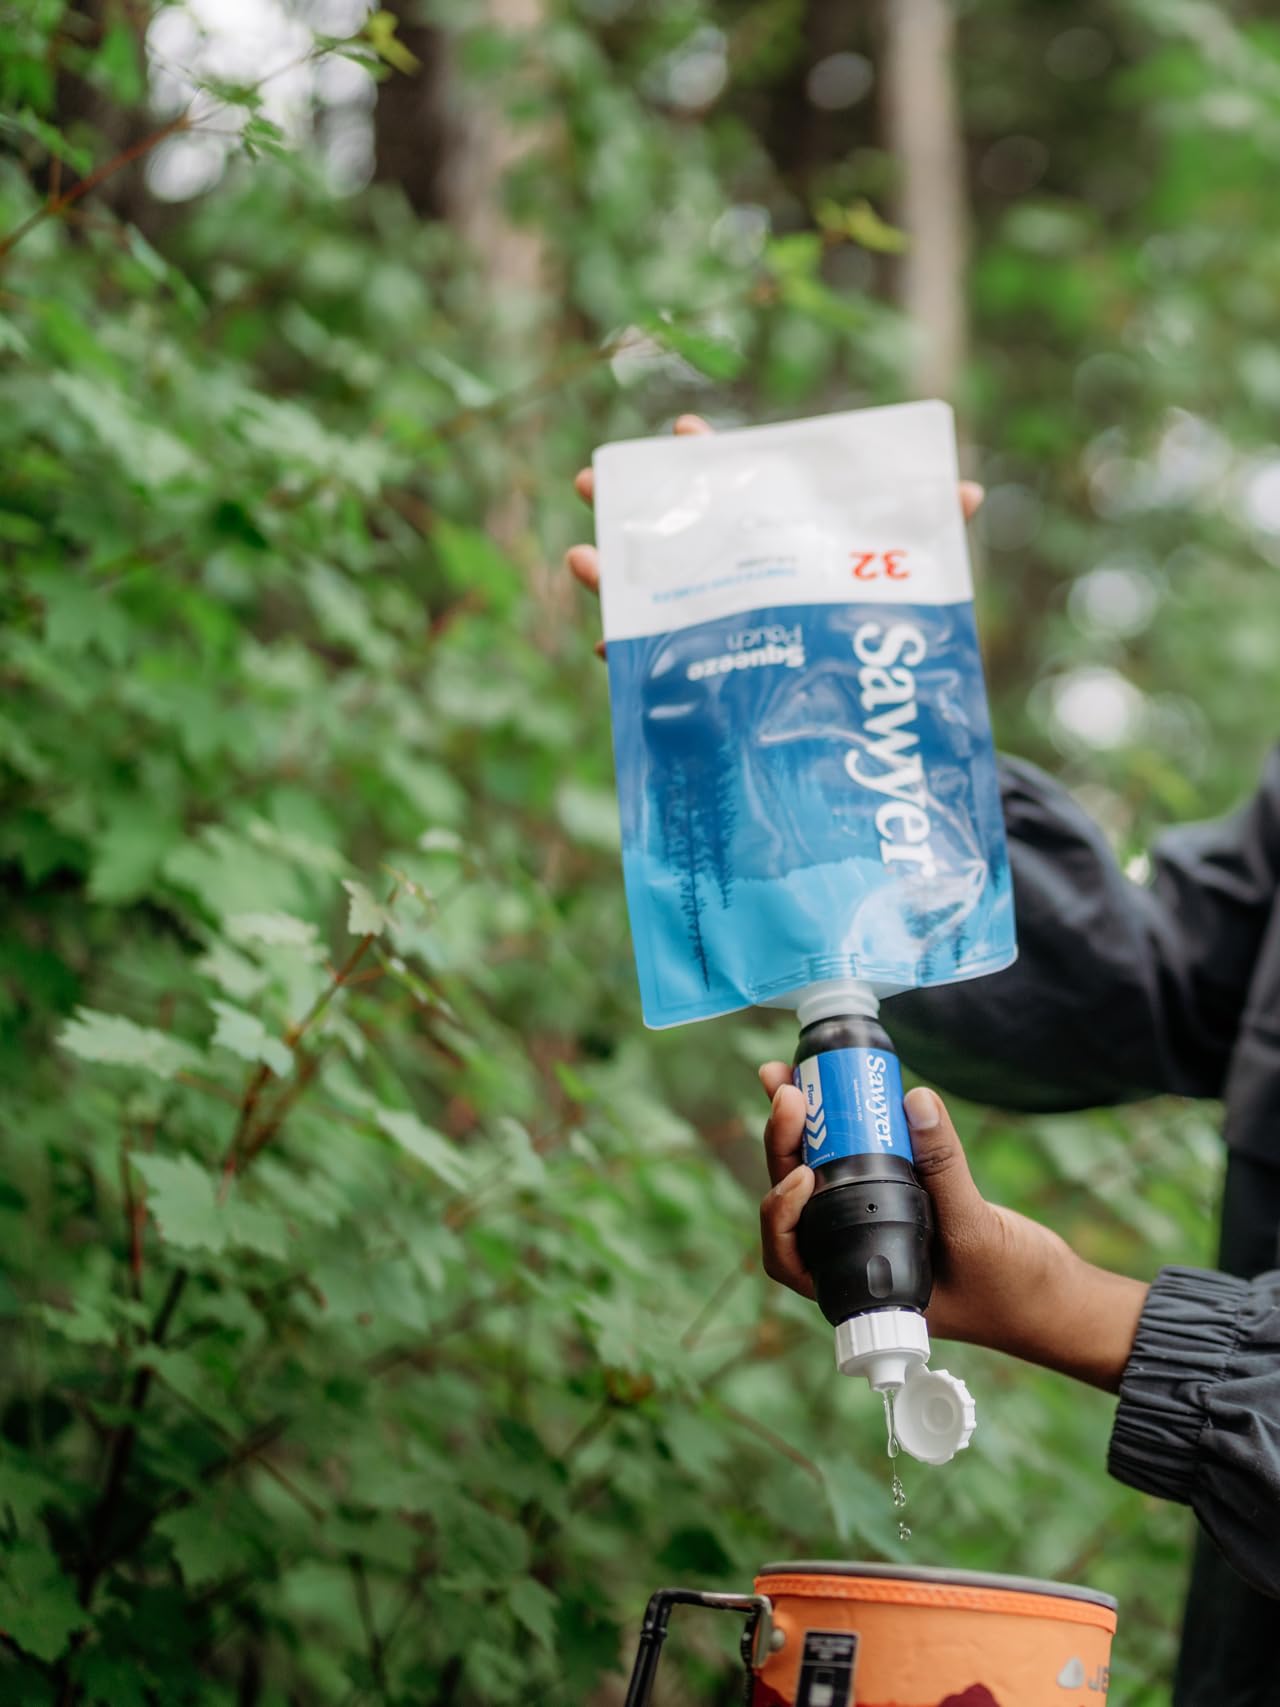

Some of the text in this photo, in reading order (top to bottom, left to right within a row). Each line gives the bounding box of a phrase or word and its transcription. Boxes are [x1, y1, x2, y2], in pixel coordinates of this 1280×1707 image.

[851, 551, 910, 580] 32
[727, 624, 802, 650] Pouch
[687, 646, 805, 681] Squeeze
[845, 622, 936, 877] Sawyer
[807, 1084, 815, 1106] Flow
[867, 1056, 894, 1147] Sawyer
